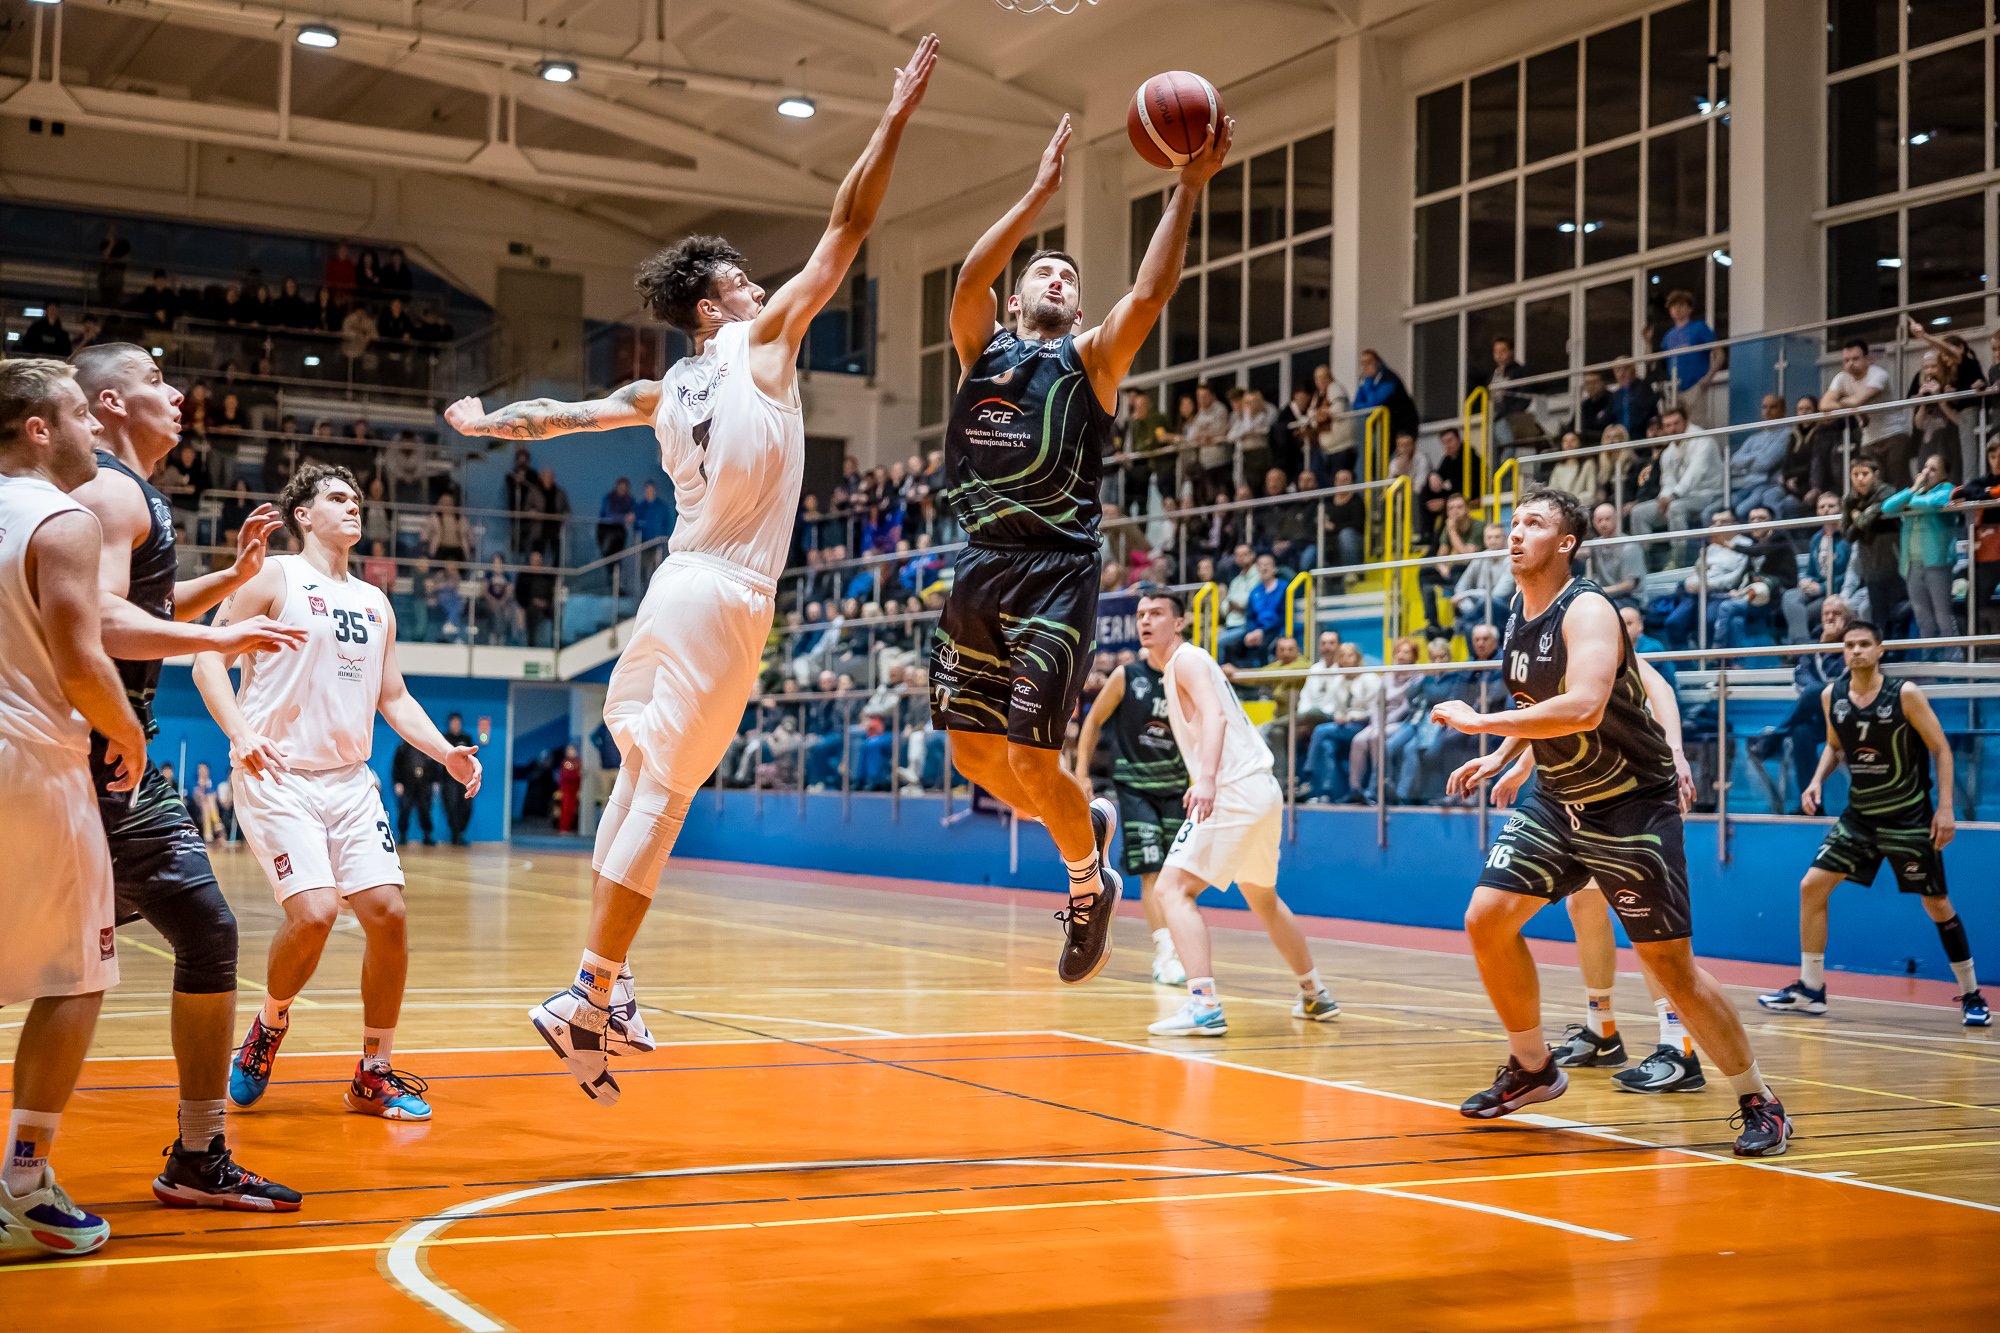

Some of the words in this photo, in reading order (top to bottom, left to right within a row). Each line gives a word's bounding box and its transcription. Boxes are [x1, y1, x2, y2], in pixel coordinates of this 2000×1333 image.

[978, 409, 1014, 424] PGE
[995, 430, 1031, 440] Energetyka
[1013, 440, 1027, 448] S.A.
[333, 608, 368, 644] 35
[1510, 649, 1530, 684] 16
[1014, 683, 1032, 695] PGE
[1152, 698, 1169, 717] 19
[1856, 721, 1870, 742] 7
[376, 821, 394, 853] 3
[1178, 822, 1193, 843] 3
[1142, 845, 1160, 864] 19
[1485, 843, 1514, 869] 16
[1816, 844, 1831, 860] 7
[1619, 895, 1636, 904] PGE
[580, 977, 609, 994] SUDETY
[364, 1087, 373, 1098] 13
